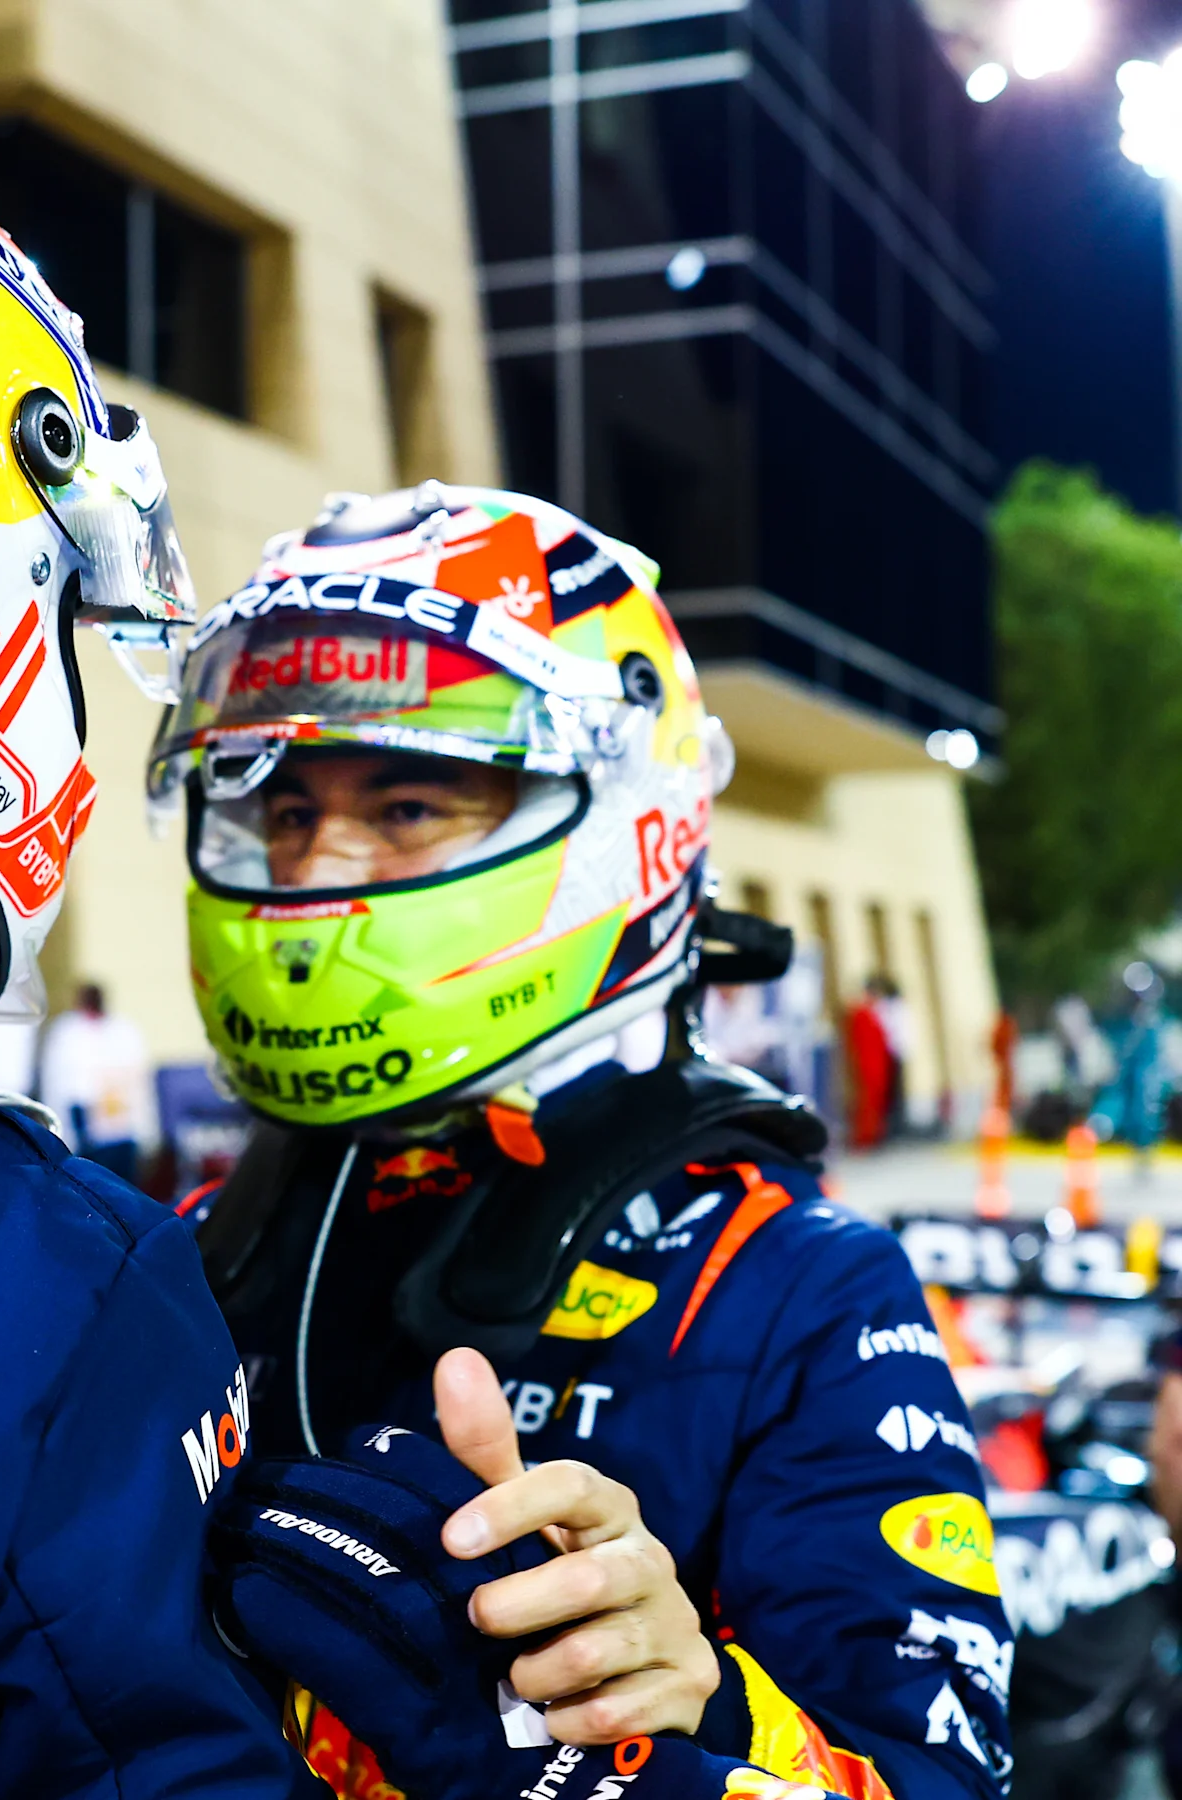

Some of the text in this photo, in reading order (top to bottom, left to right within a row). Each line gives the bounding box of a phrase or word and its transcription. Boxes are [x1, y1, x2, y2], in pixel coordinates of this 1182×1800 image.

[311, 636, 408, 684] Bull
[18, 836, 61, 898] BYBIT
[258, 1016, 385, 1050] inter.mx
[560, 1283, 640, 1320] UCH
[520, 1744, 585, 1800] inte
